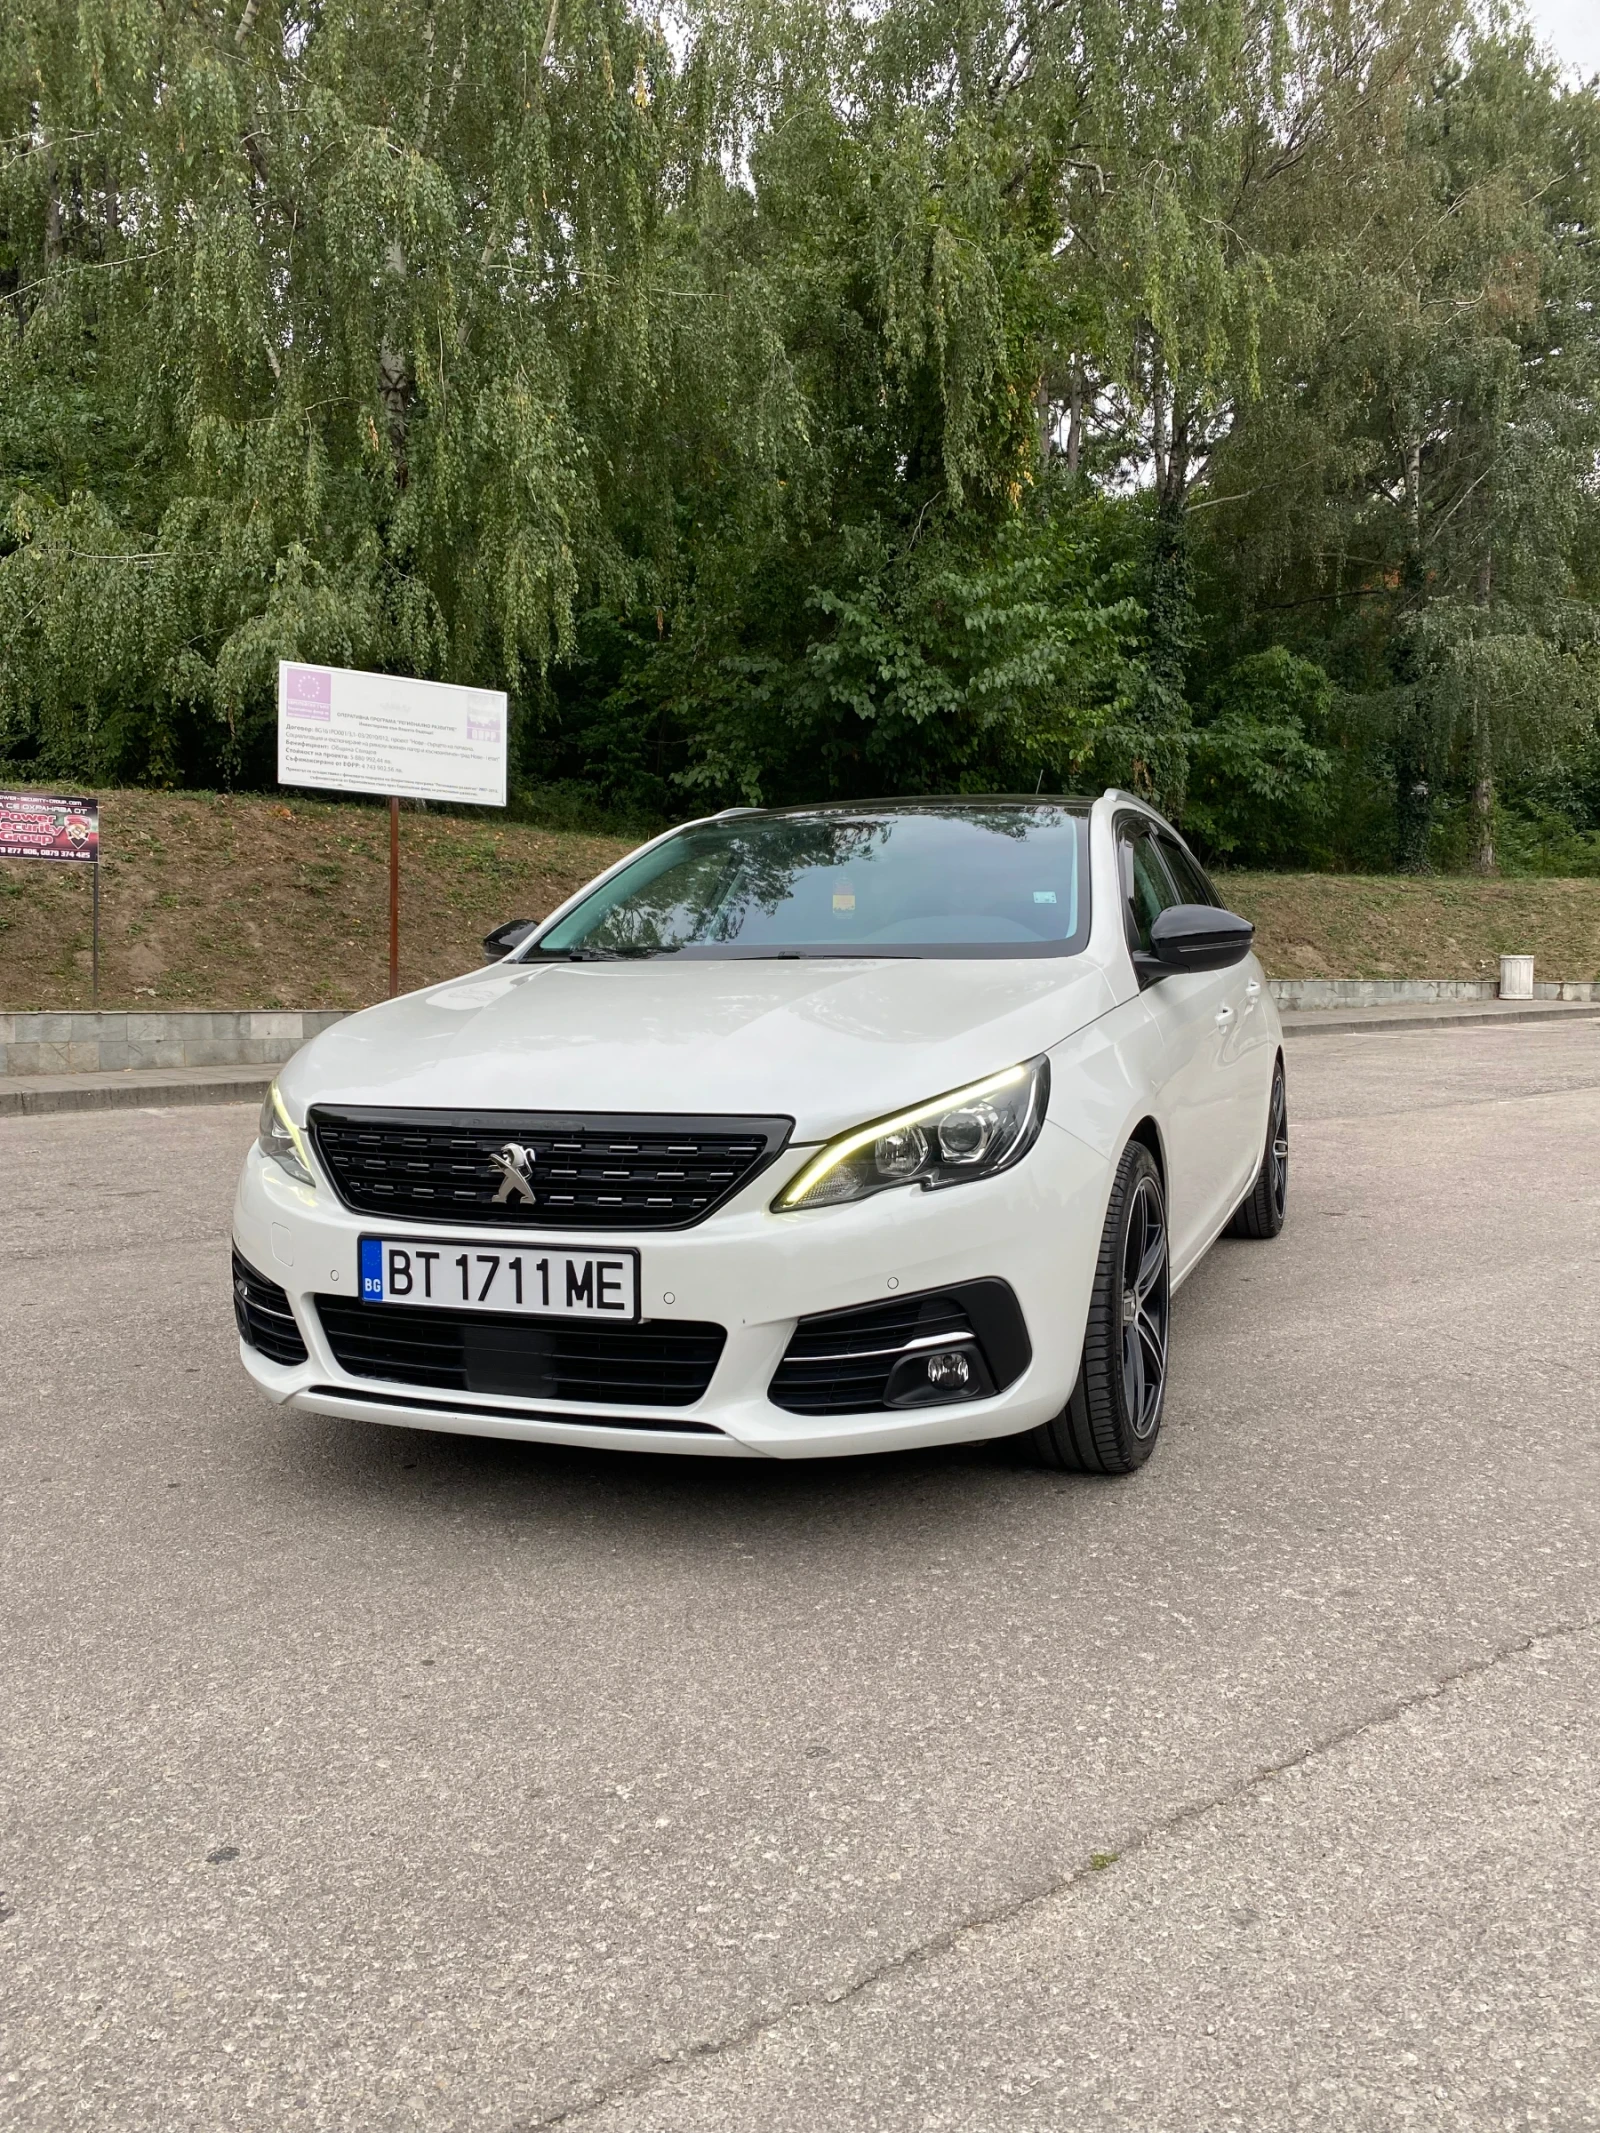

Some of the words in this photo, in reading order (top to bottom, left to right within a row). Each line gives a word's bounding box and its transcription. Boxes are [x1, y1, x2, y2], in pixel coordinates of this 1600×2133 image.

[0, 810, 57, 824] Power
[0, 821, 65, 836] ecurity
[0, 830, 54, 846] Group
[60, 850, 75, 858] 374
[364, 1278, 382, 1293] BG
[388, 1248, 440, 1298] BT
[455, 1253, 550, 1306] 1711
[565, 1259, 626, 1311] ME
